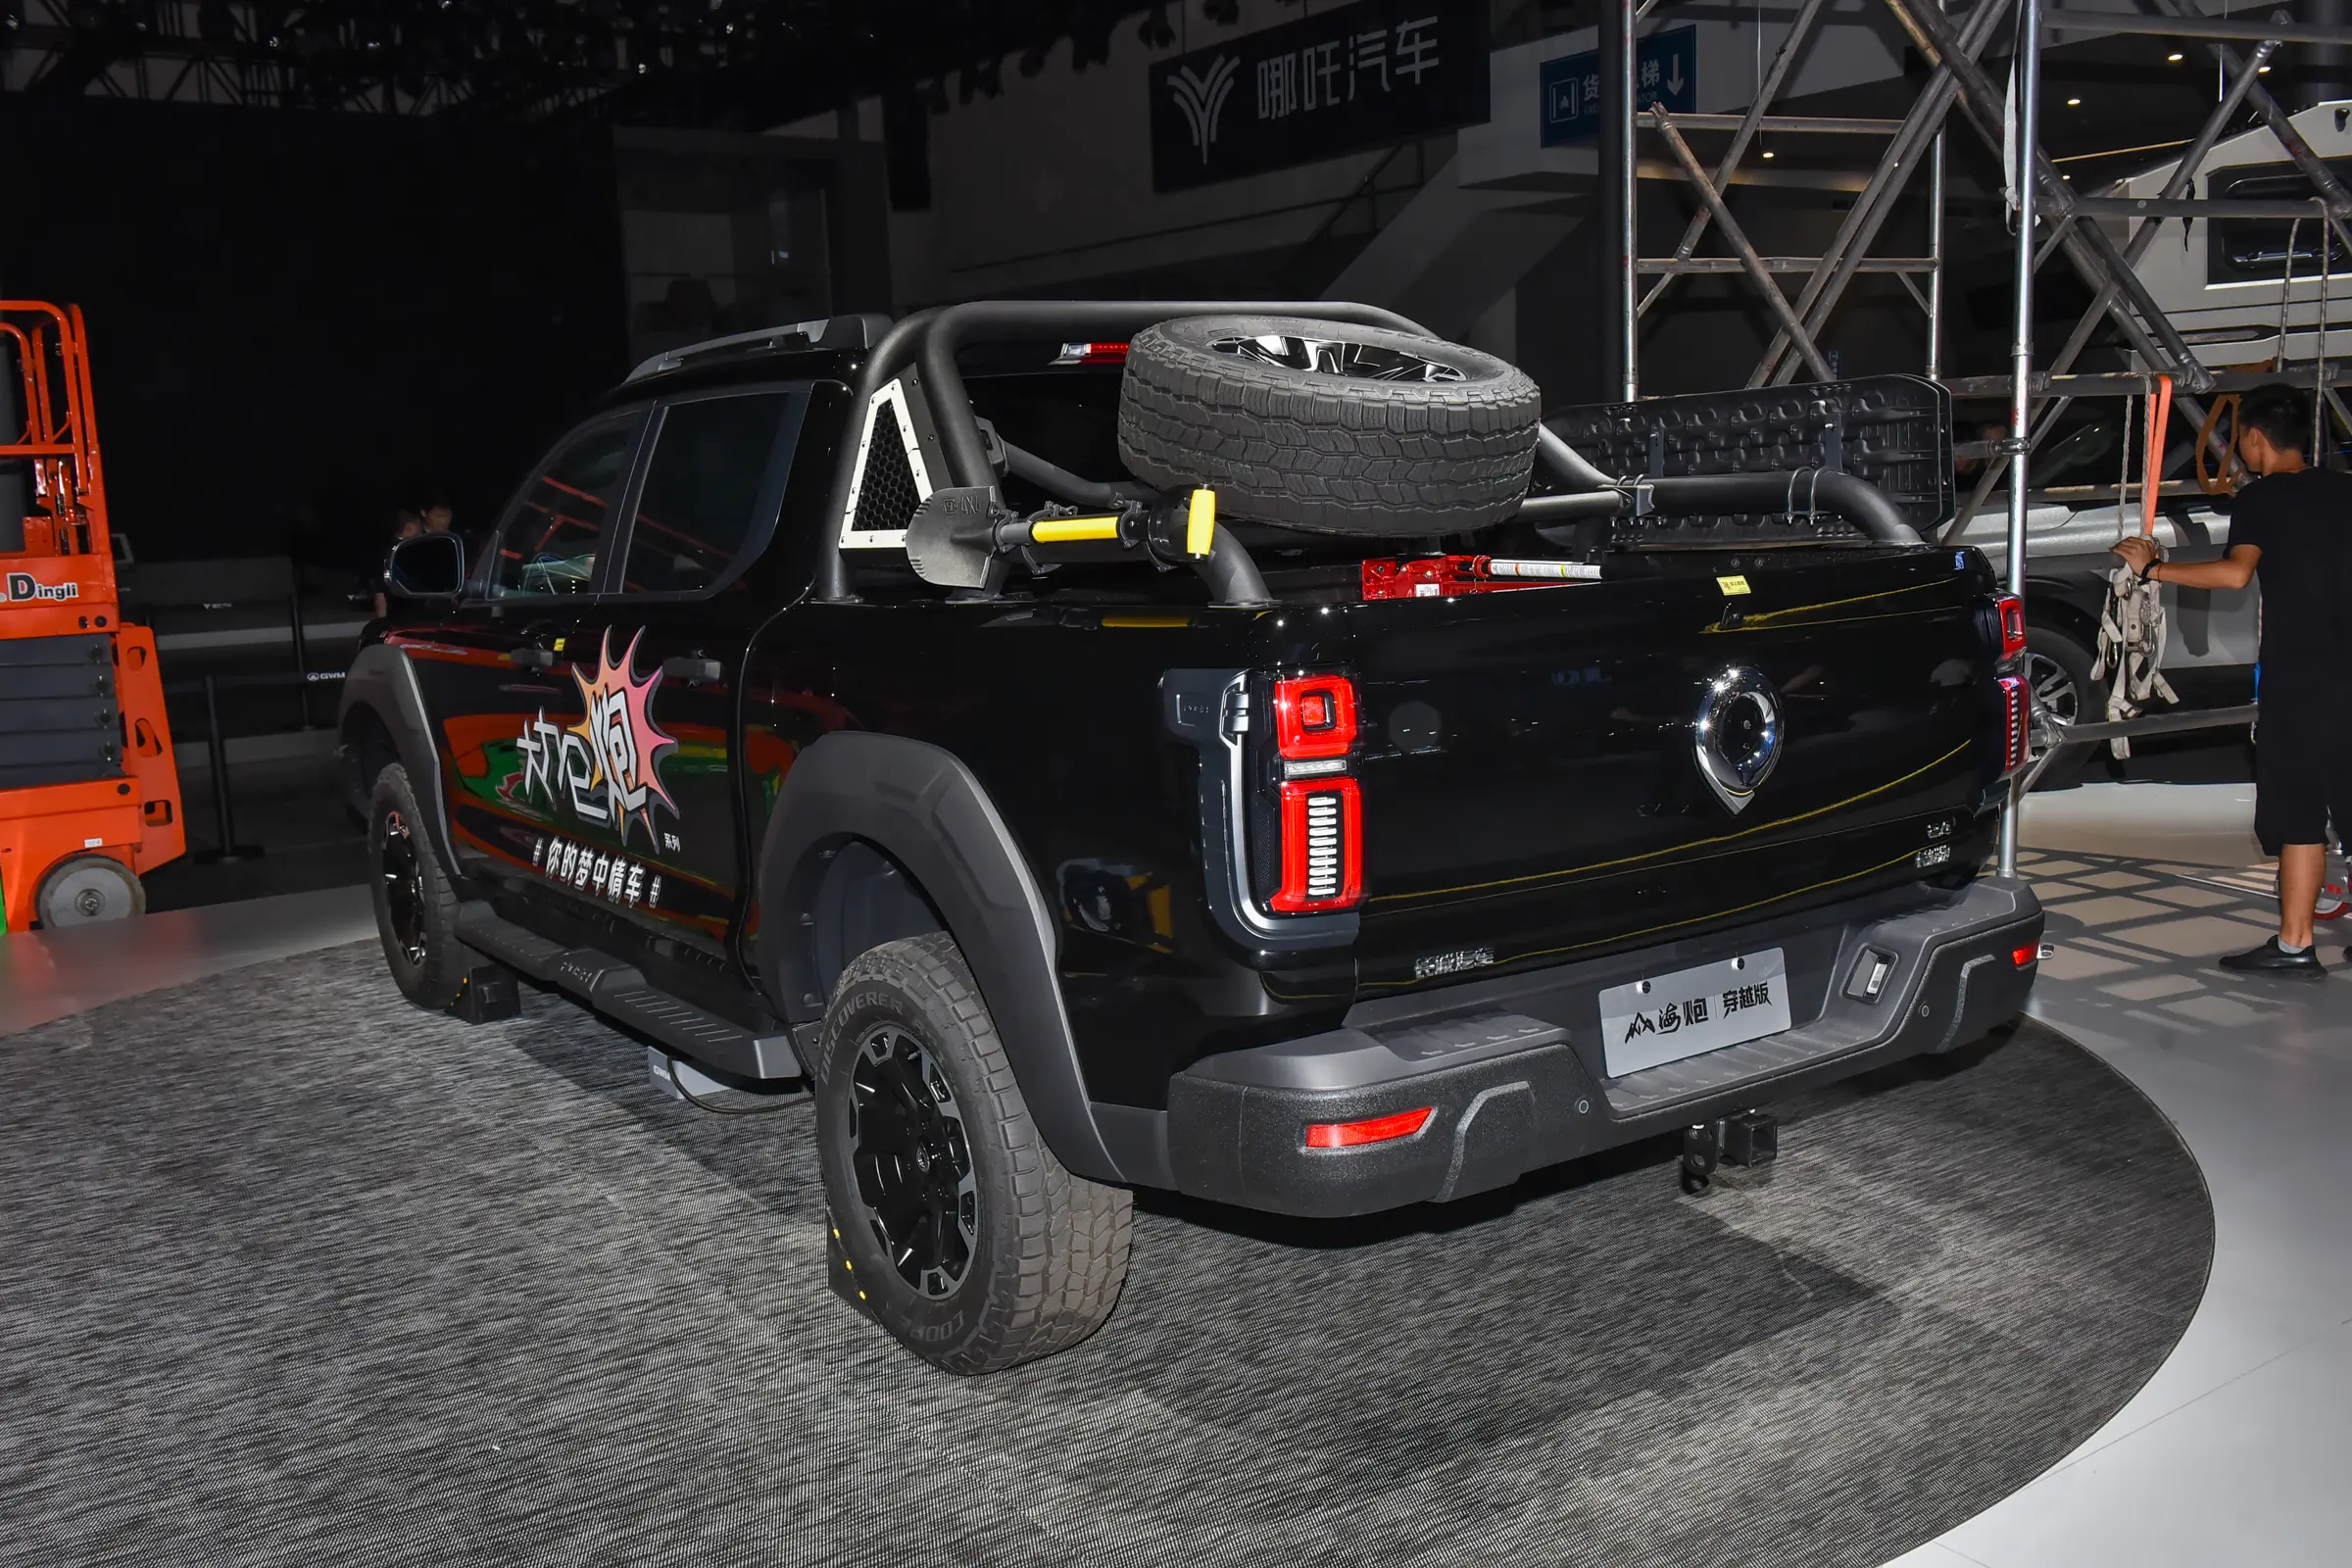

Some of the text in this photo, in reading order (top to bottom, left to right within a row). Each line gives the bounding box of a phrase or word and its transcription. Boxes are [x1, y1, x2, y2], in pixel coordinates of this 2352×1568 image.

[1257, 16, 1440, 120] 哪吒汽车
[7, 572, 78, 602] Dingli
[319, 671, 346, 680] GWM
[663, 832, 681, 854] 系列
[1722, 981, 1774, 1019] 穿越版
[820, 991, 904, 1085] DISCOVERER
[891, 1307, 965, 1343] COOPE
